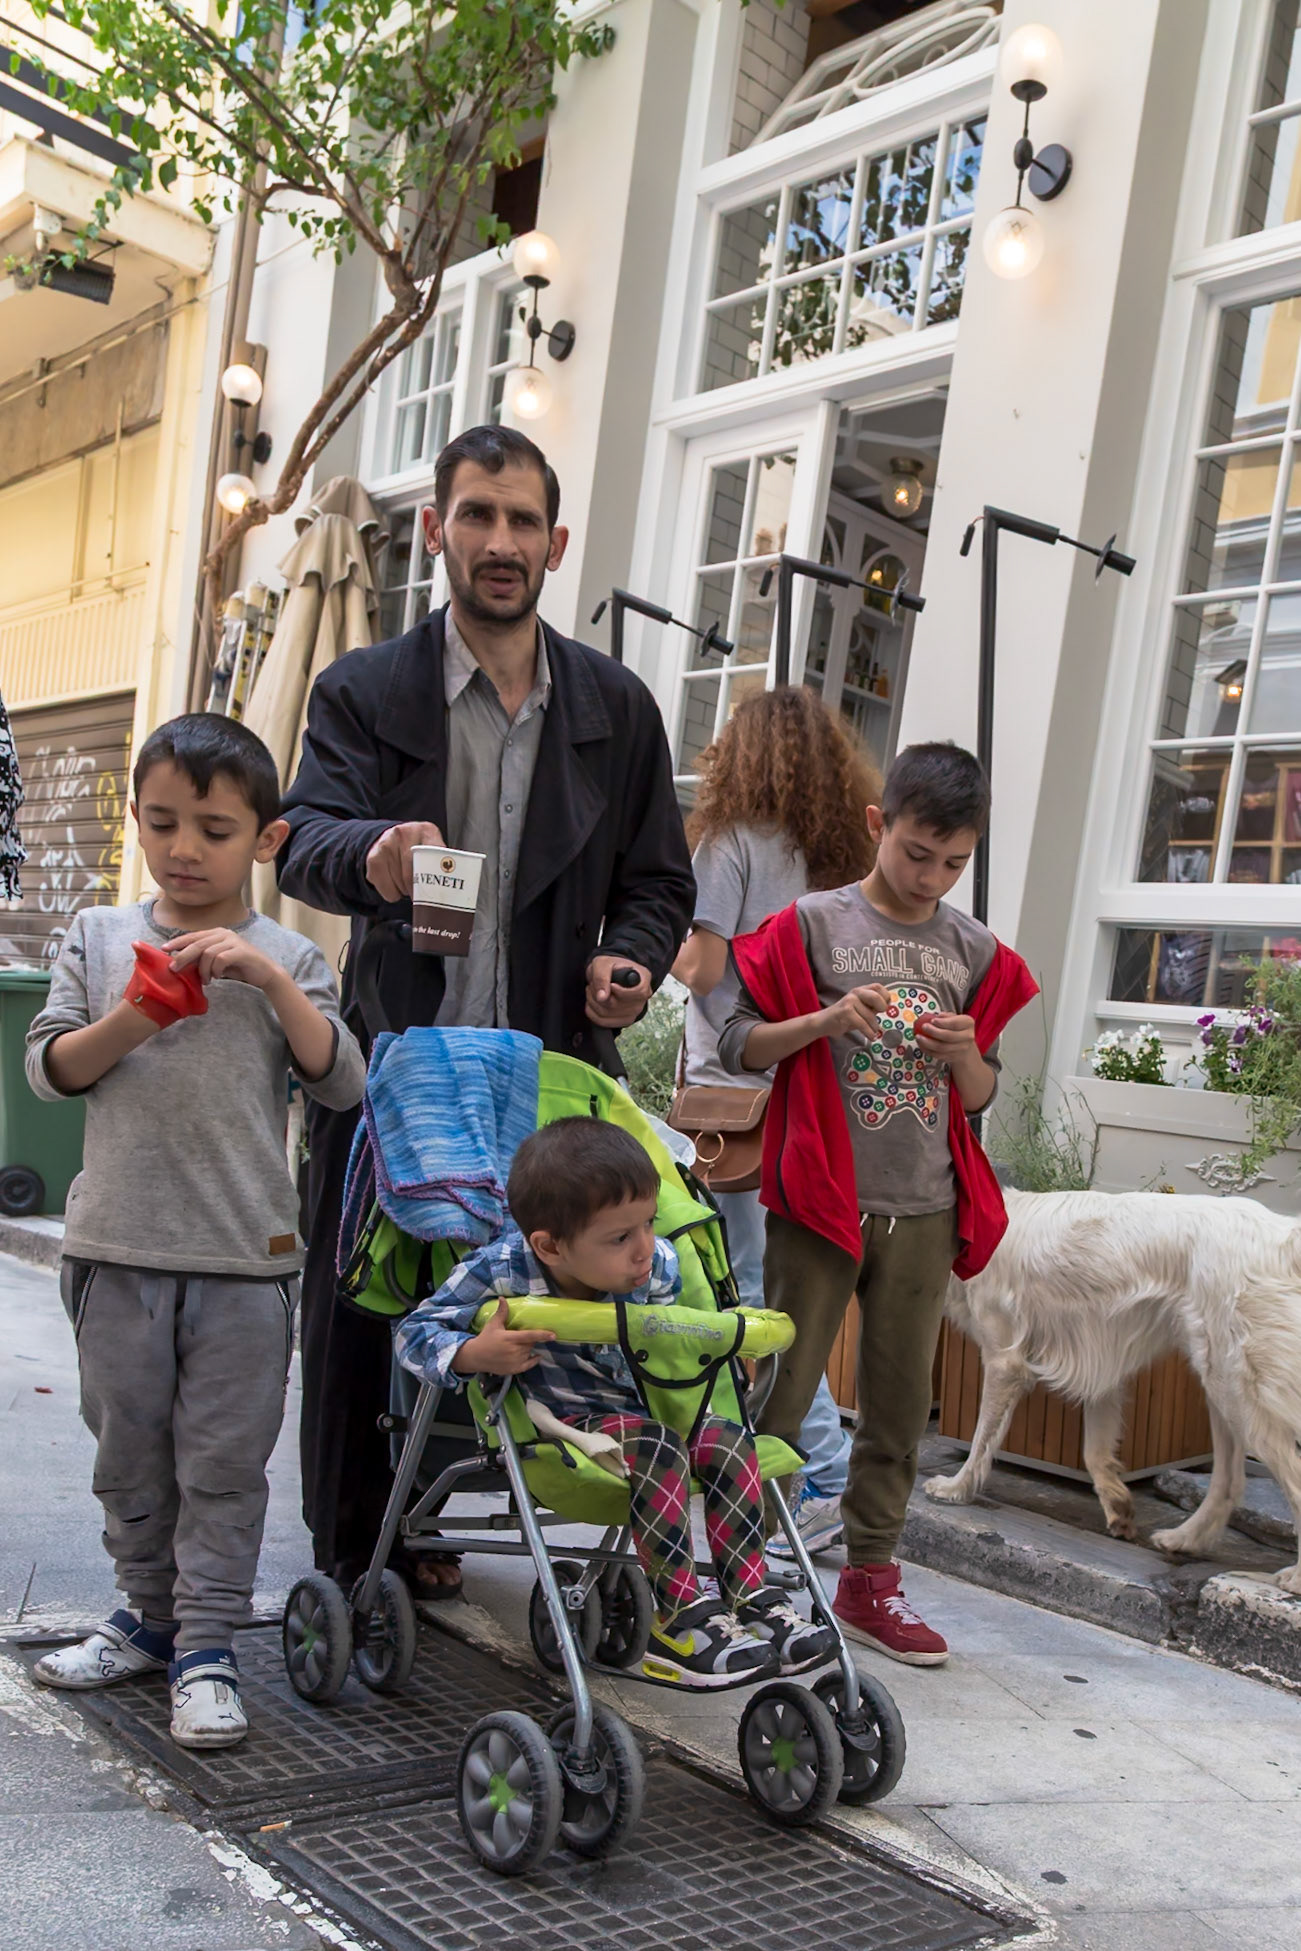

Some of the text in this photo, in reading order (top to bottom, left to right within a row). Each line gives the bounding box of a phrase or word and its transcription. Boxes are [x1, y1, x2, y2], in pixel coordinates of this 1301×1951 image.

[420, 873, 465, 890] VENETI
[427, 926, 440, 936] last
[440, 929, 461, 940] drop!
[870, 939, 940, 955] PEOPLE FOR
[832, 947, 969, 991] SMALL GANG
